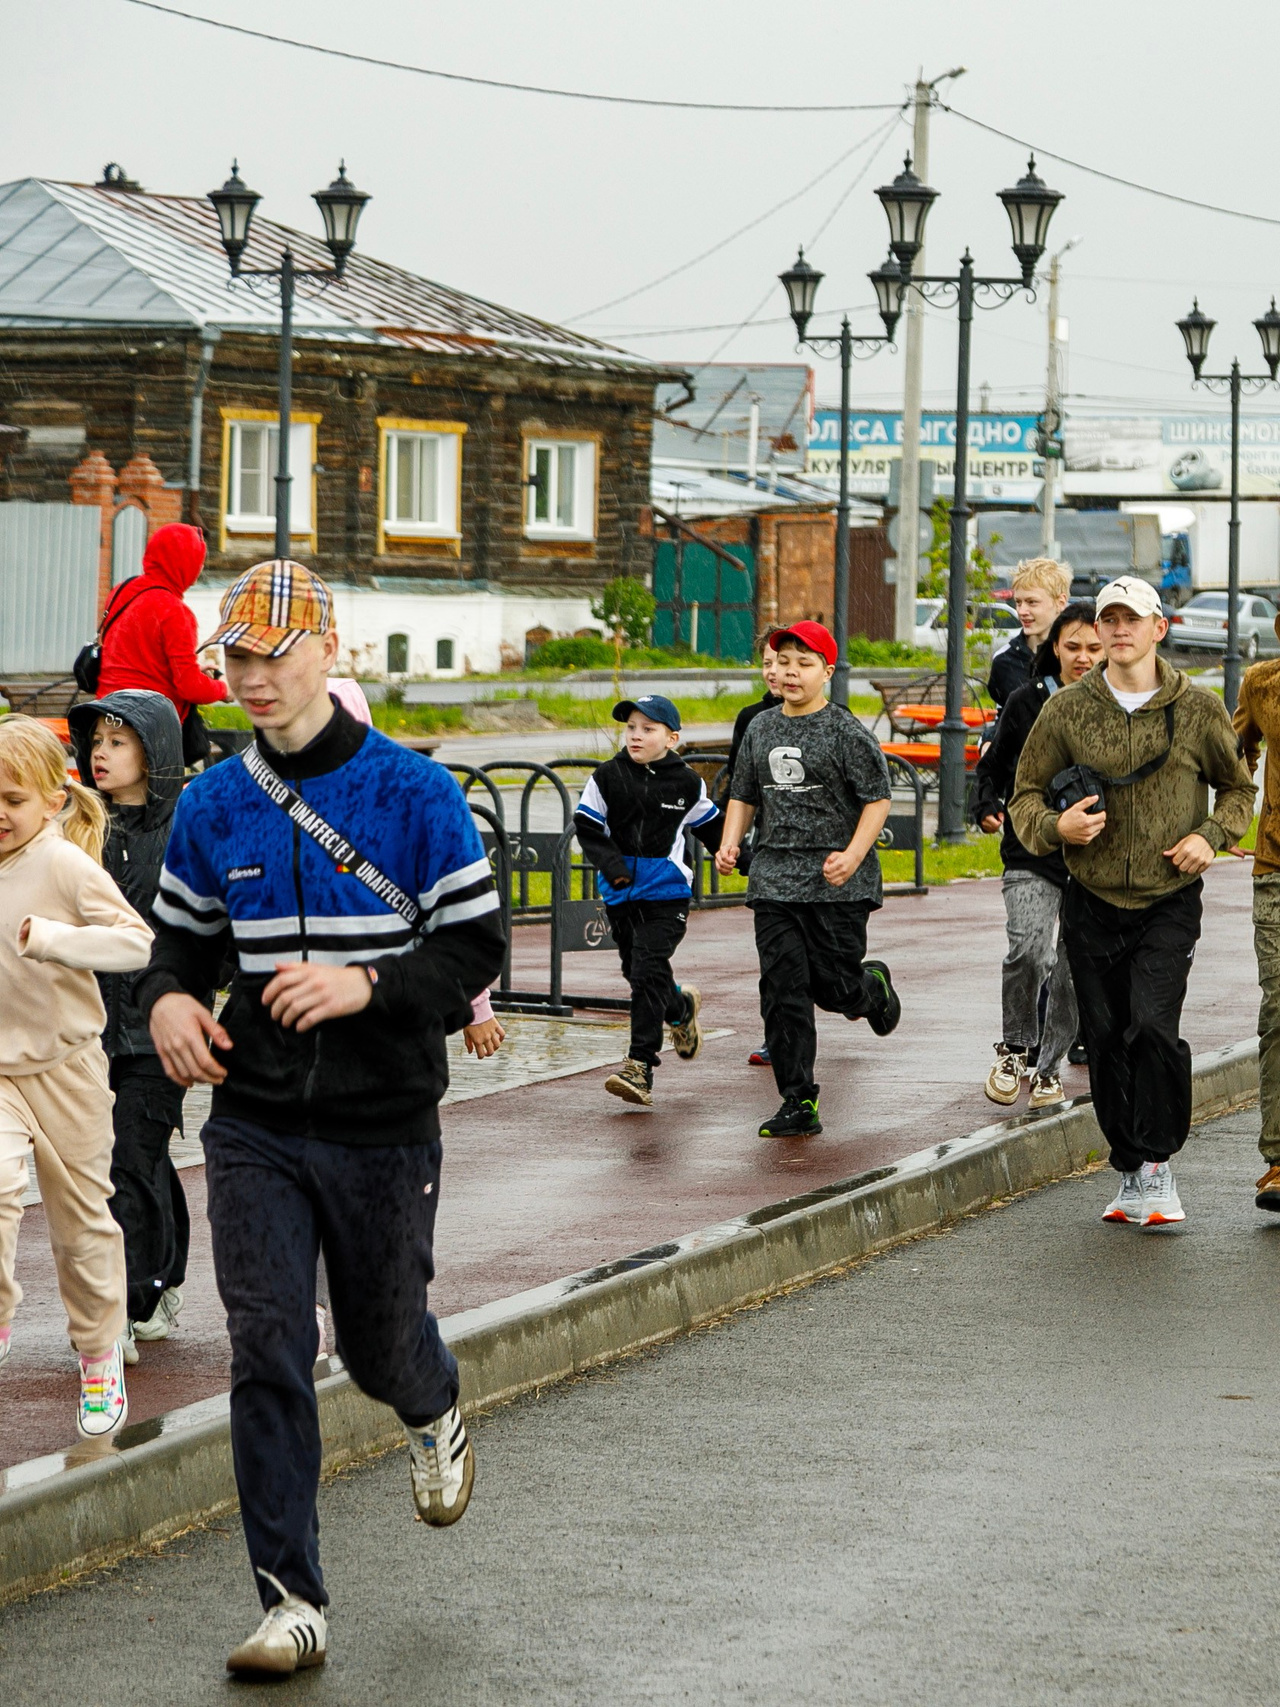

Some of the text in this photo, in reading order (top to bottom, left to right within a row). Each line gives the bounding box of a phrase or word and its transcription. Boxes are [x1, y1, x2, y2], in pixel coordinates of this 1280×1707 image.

[806, 419, 888, 442] ОЛСА
[1221, 451, 1266, 462] рмонт
[969, 460, 1029, 478] ЦЕНТР
[769, 747, 805, 784] 6
[242, 744, 290, 806] UNAFFECTED
[355, 860, 420, 923] UNAFFECTED
